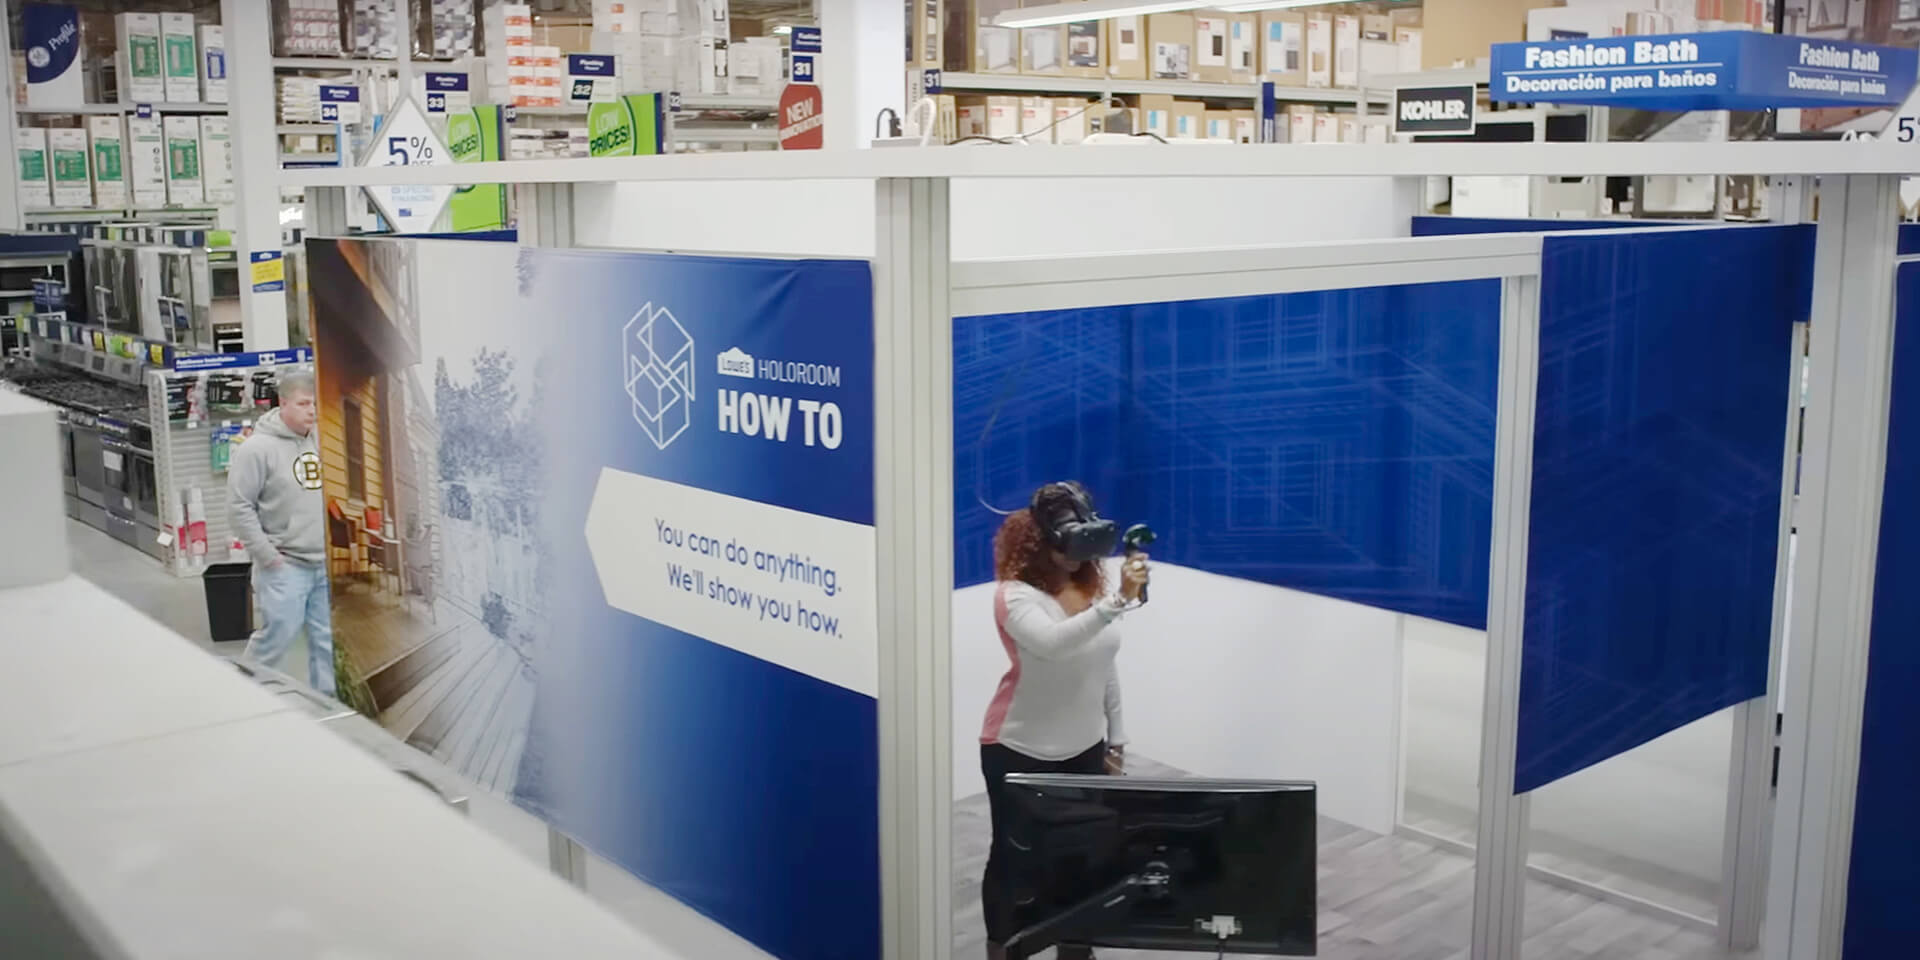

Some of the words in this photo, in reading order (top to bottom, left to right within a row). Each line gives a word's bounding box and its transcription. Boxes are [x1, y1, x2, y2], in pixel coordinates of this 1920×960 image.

[1525, 44, 1627, 69] Fashion
[1633, 39, 1699, 64] Bath
[1799, 42, 1850, 69] Fashion
[1851, 48, 1880, 72] Bath
[794, 62, 811, 76] 31
[925, 73, 940, 87] 31
[1506, 73, 1606, 93] Decoración
[1610, 74, 1653, 93] para
[1658, 69, 1717, 88] baños
[573, 85, 592, 95] 32
[1788, 71, 1840, 92] Decoración
[1840, 79, 1860, 96] para
[322, 107, 338, 118] 34
[428, 97, 444, 109] 33
[786, 98, 814, 125] NEW
[590, 123, 630, 155] PRICES!
[1898, 116, 1920, 142] 5
[389, 137, 433, 165] 5%
[758, 359, 840, 387] HOLOROOM
[718, 388, 792, 442] HOW
[798, 399, 842, 449] TO
[304, 461, 320, 480] B
[655, 517, 684, 547] You
[688, 533, 720, 559] can
[725, 537, 748, 566] do
[754, 551, 842, 597] anything.
[667, 562, 704, 596] We'll
[708, 576, 752, 611] show
[757, 594, 792, 621] you
[798, 600, 843, 639] how.
